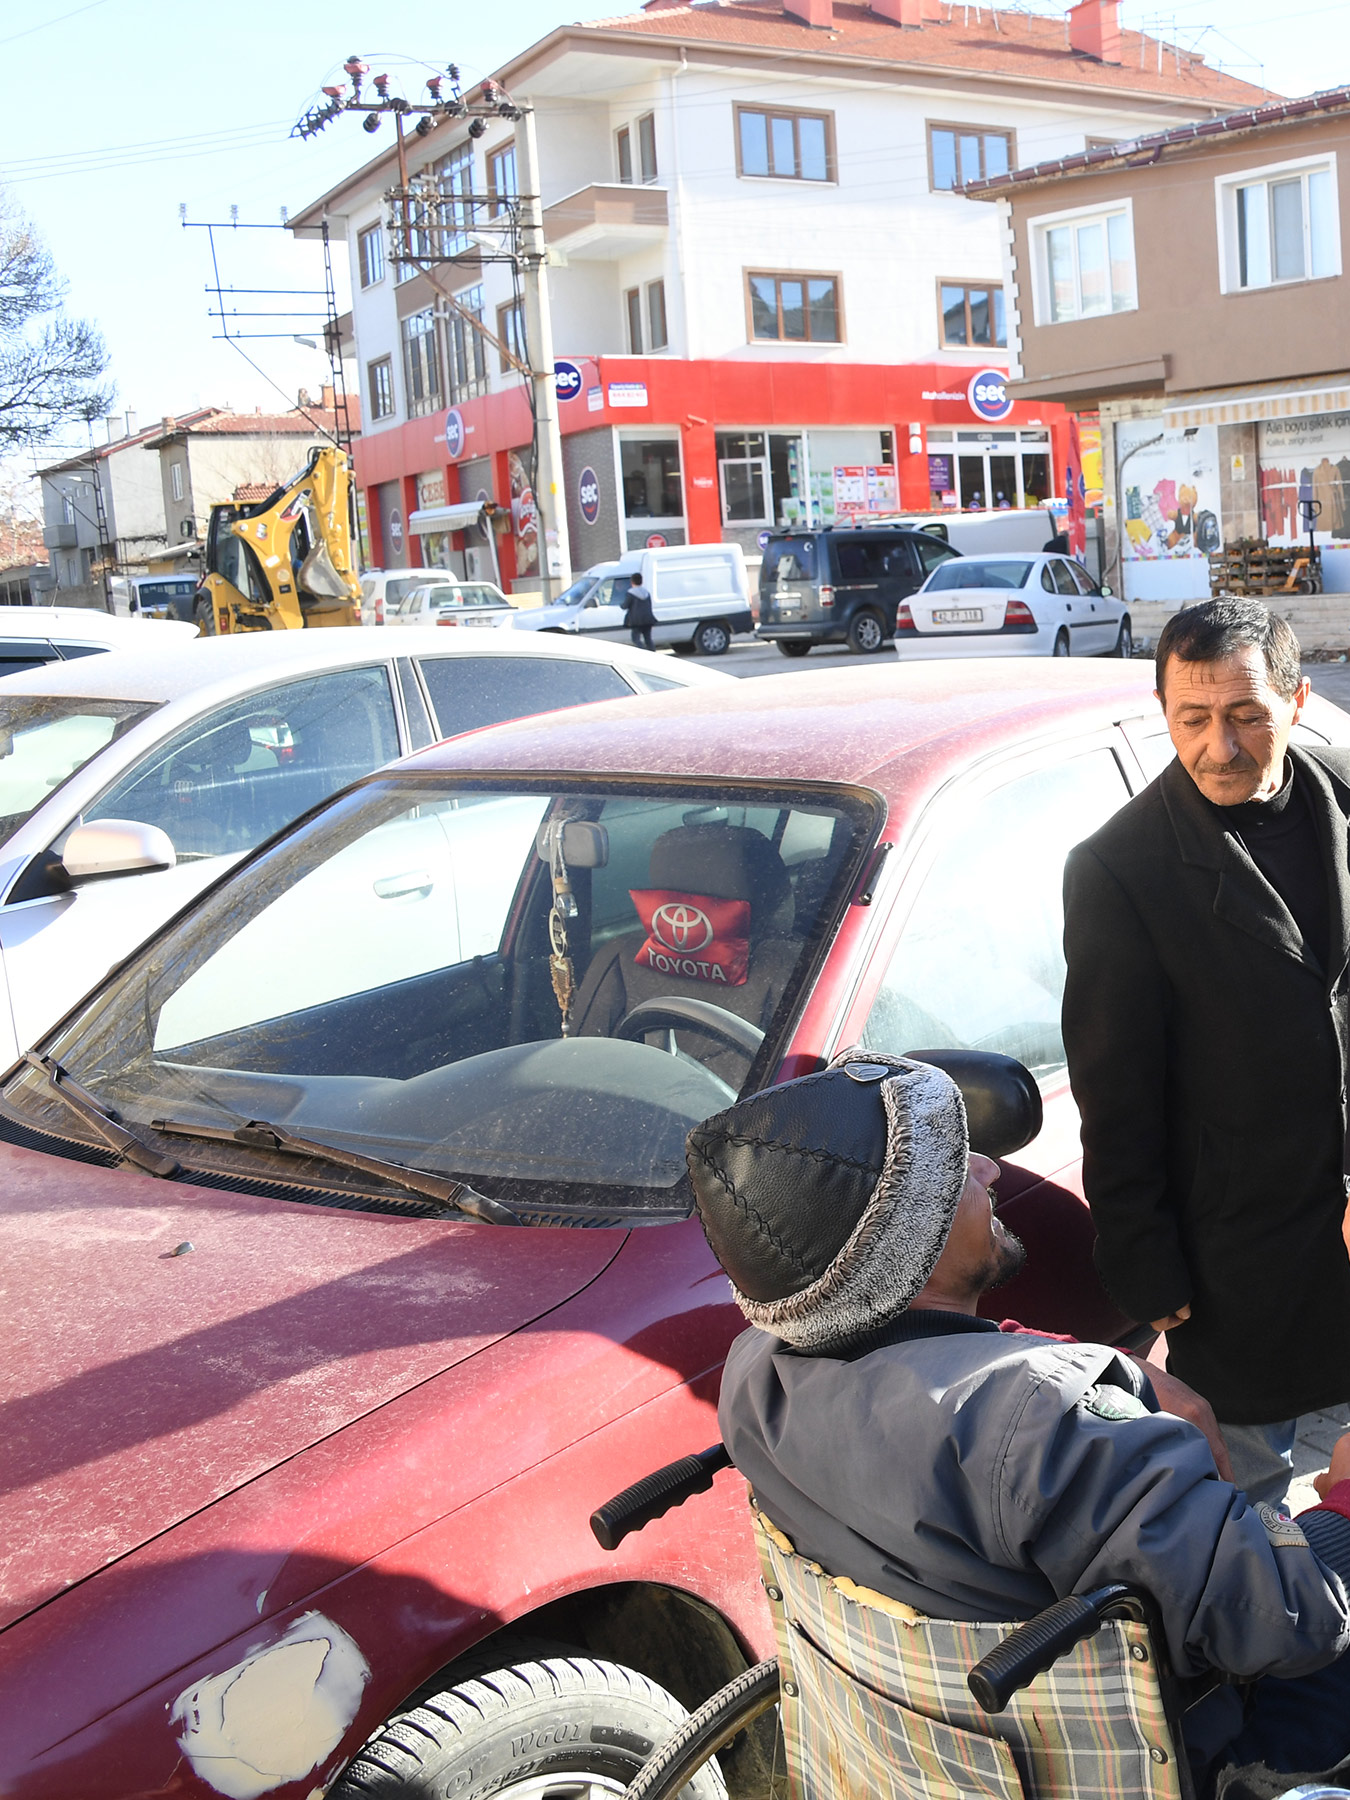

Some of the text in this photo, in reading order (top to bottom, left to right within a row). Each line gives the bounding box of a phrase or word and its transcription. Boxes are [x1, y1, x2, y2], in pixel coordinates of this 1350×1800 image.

[555, 371, 579, 388] eç
[648, 947, 727, 982] TOYOTA
[511, 1720, 585, 1758] W601
